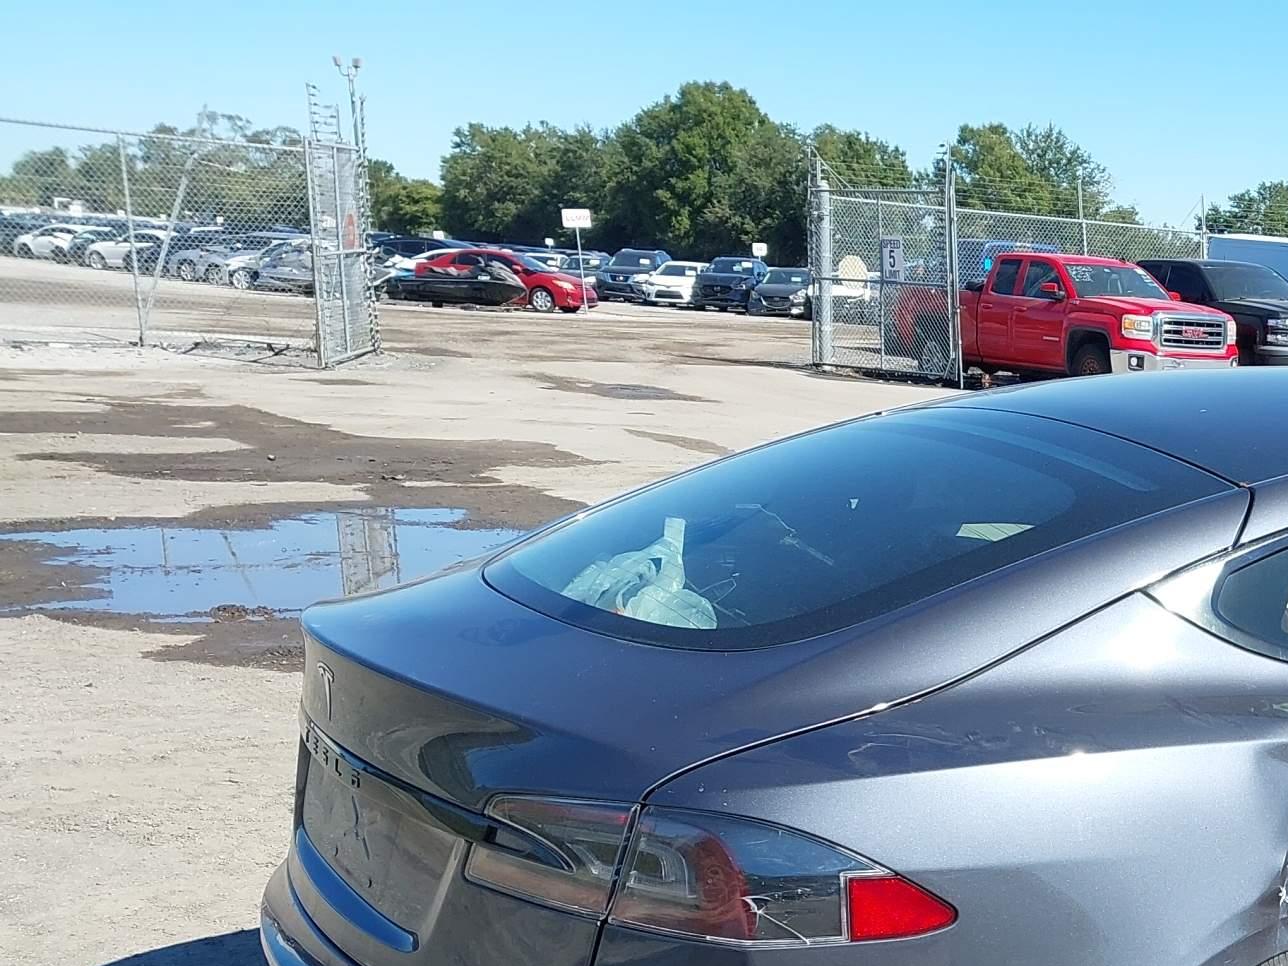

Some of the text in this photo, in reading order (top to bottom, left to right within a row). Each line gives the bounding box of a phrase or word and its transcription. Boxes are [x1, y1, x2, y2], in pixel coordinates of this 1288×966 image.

[881, 239, 901, 249] SPEED
[888, 249, 896, 268] 5
[884, 269, 901, 279] LIMIT
